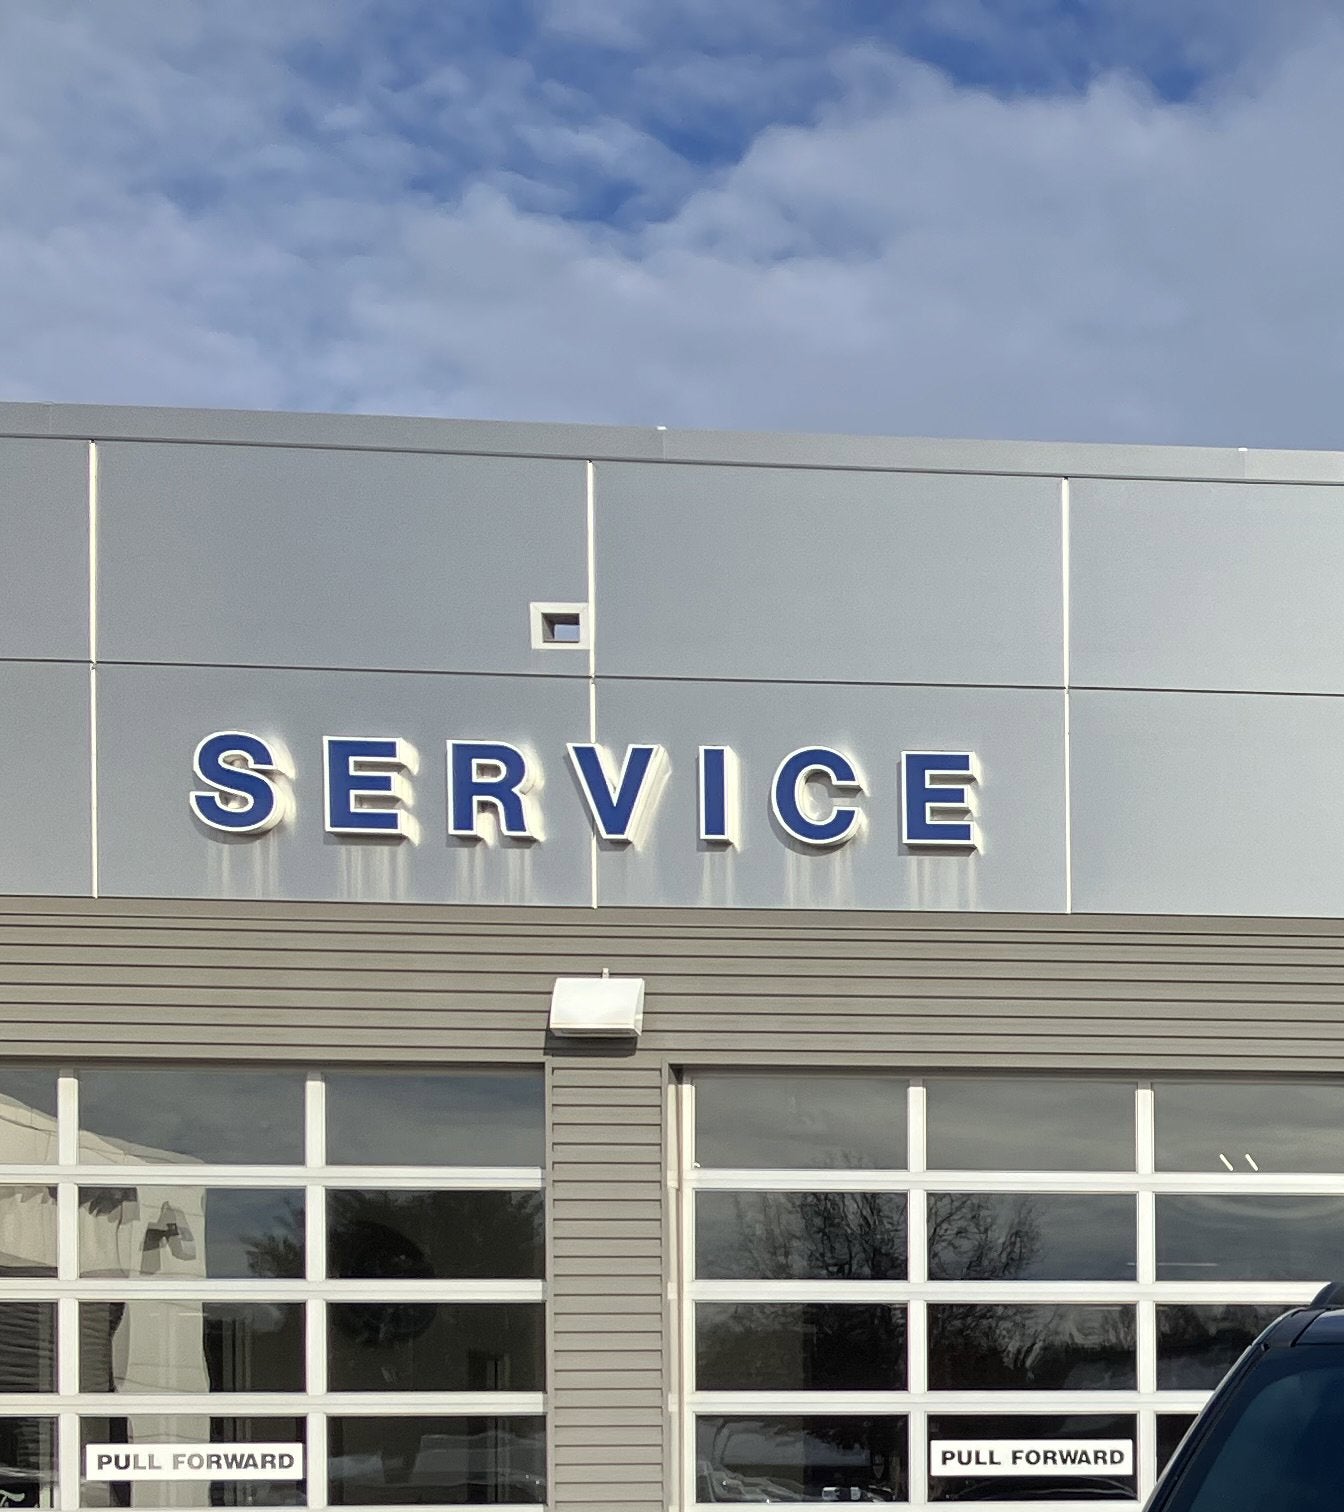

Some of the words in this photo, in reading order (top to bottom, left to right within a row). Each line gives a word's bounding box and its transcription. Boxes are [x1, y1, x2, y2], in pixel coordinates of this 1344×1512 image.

[190, 730, 982, 847] SERVICE
[96, 1453, 162, 1470] PULL
[172, 1452, 295, 1470] FORWARD
[941, 1449, 1002, 1466] PULL
[1011, 1449, 1125, 1466] FORWARD
